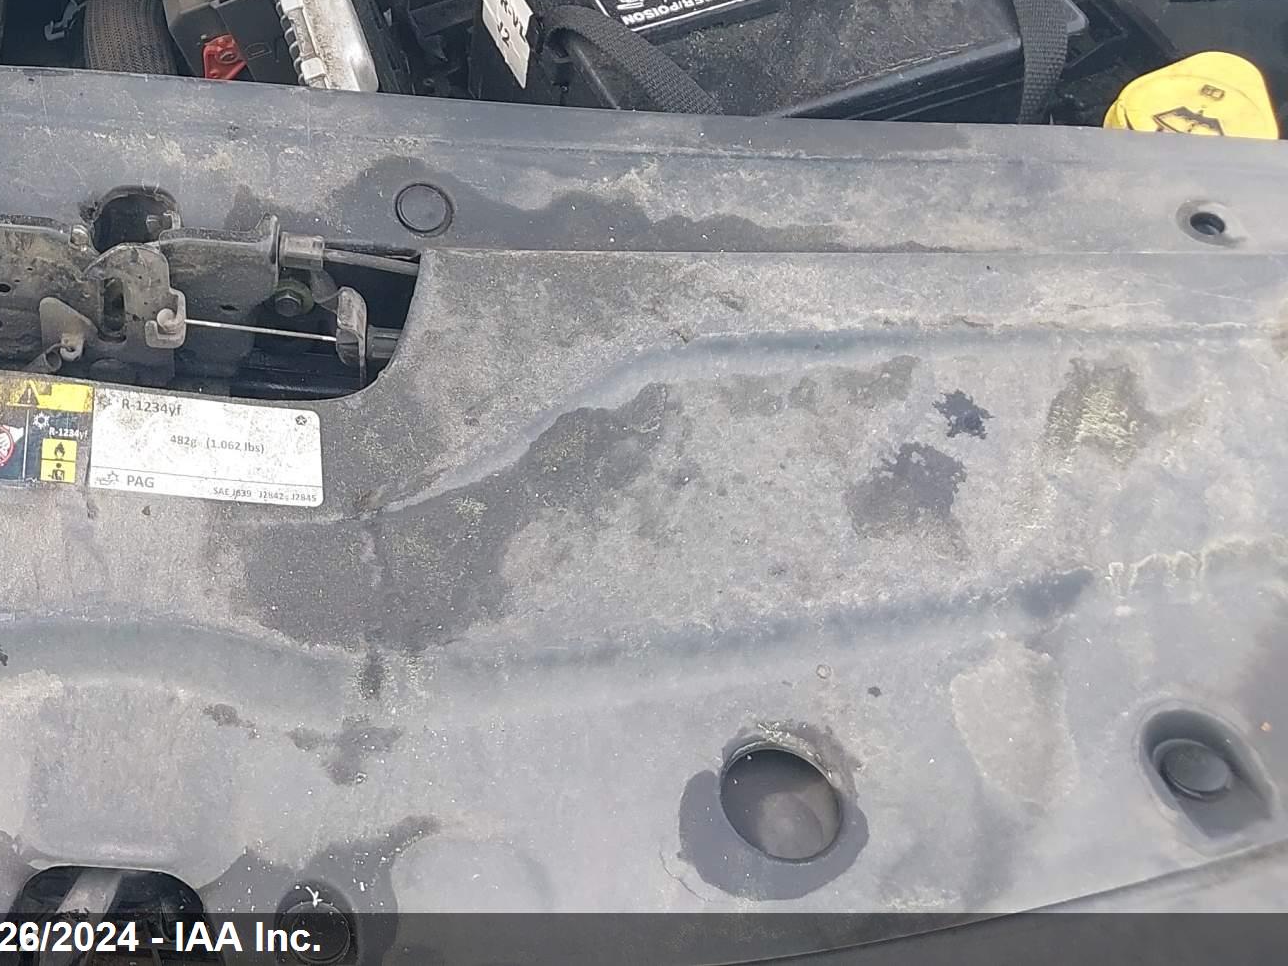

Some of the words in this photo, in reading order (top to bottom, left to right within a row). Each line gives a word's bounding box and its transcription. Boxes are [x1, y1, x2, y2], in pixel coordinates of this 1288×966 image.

[122, 399, 182, 416] R-1234yf
[49, 427, 88, 439] R-1234yf
[170, 434, 197, 448] 482g
[206, 437, 241, 451] (1.062
[244, 439, 265, 454] lbs)
[127, 475, 154, 488] PAG
[213, 487, 230, 495] SAE
